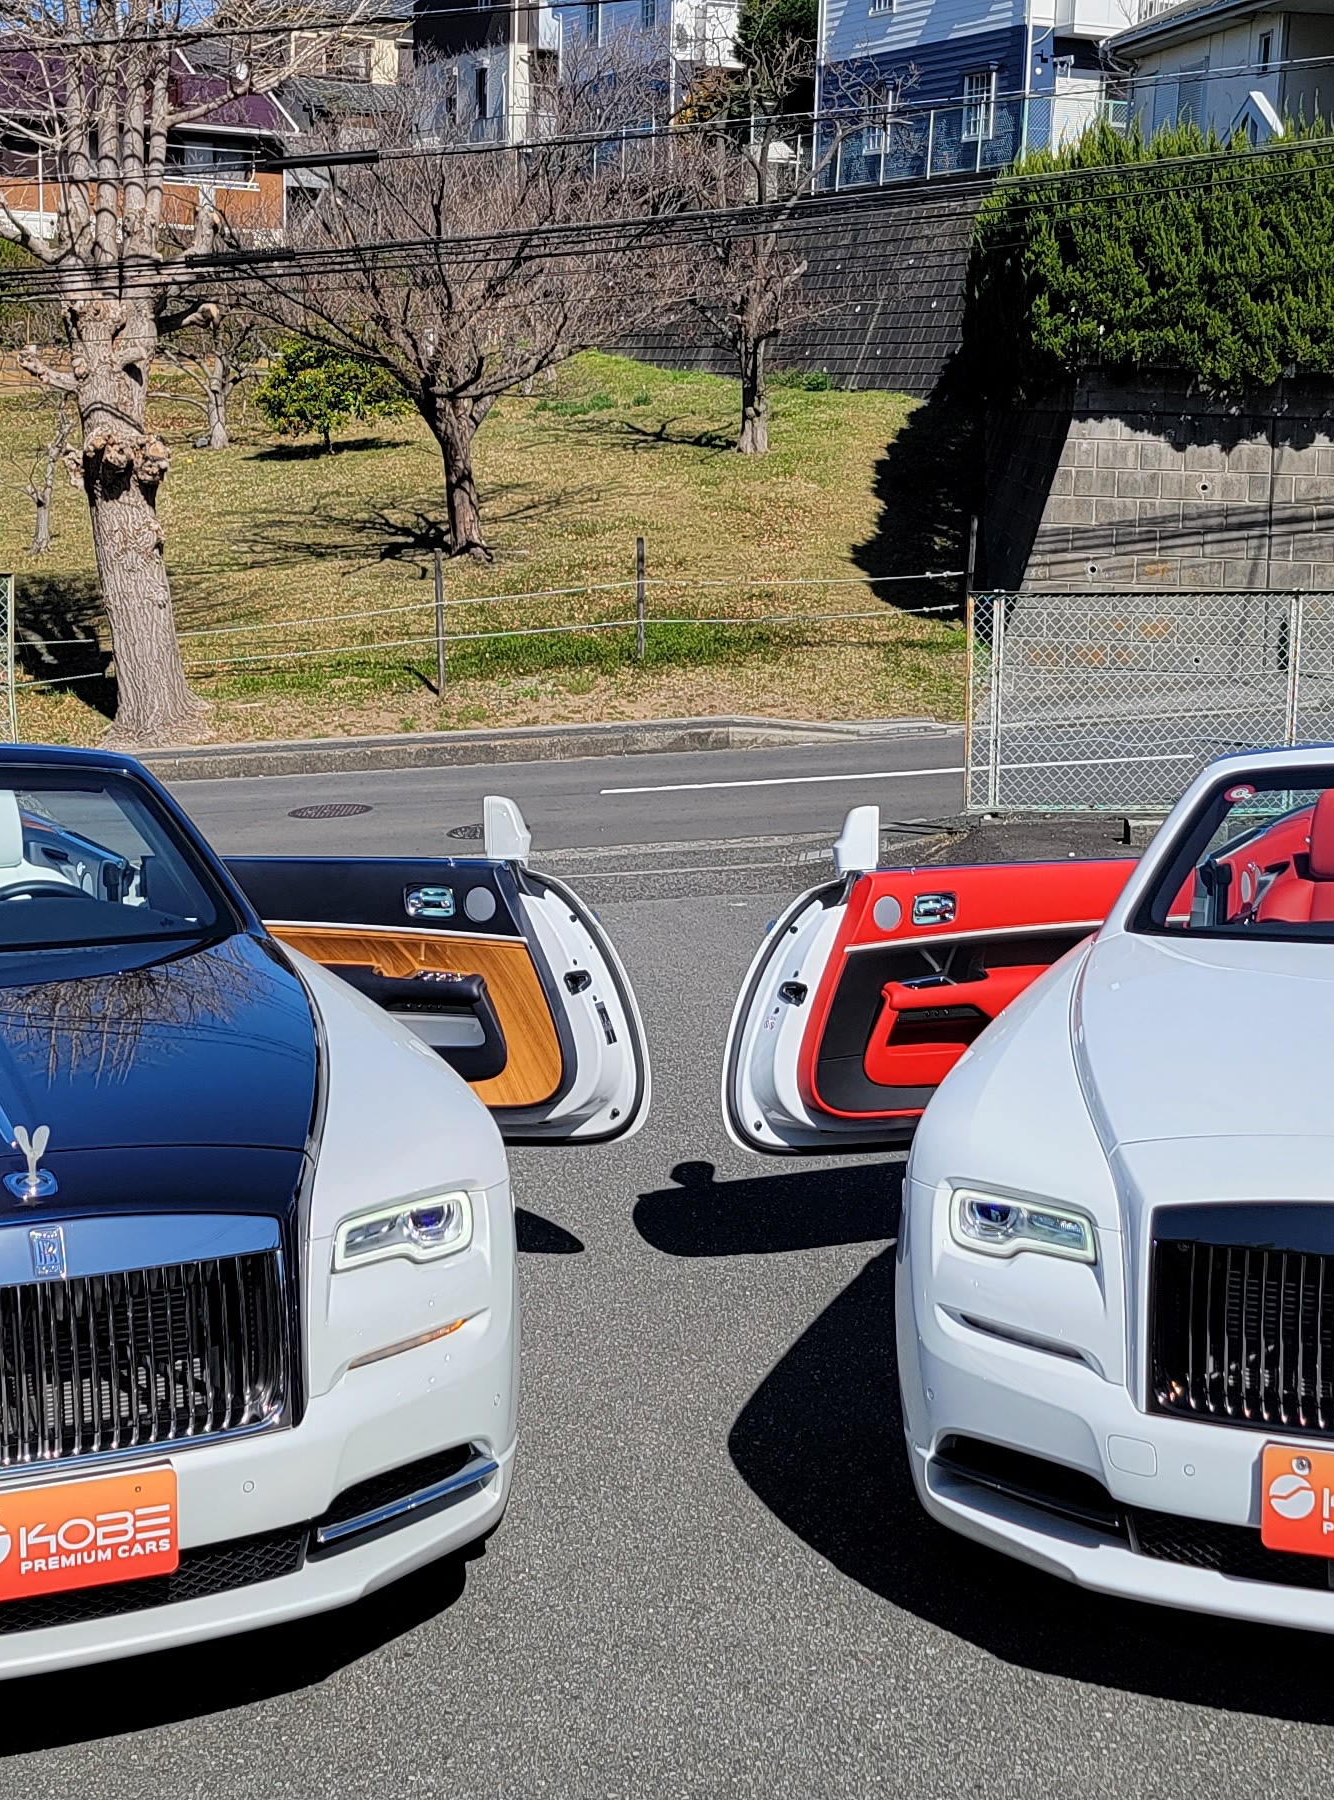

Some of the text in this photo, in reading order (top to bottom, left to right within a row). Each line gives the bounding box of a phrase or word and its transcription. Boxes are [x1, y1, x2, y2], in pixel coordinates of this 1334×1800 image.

[19, 1503, 171, 1559] KOBE
[20, 1538, 171, 1575] PREMIUM CARS
